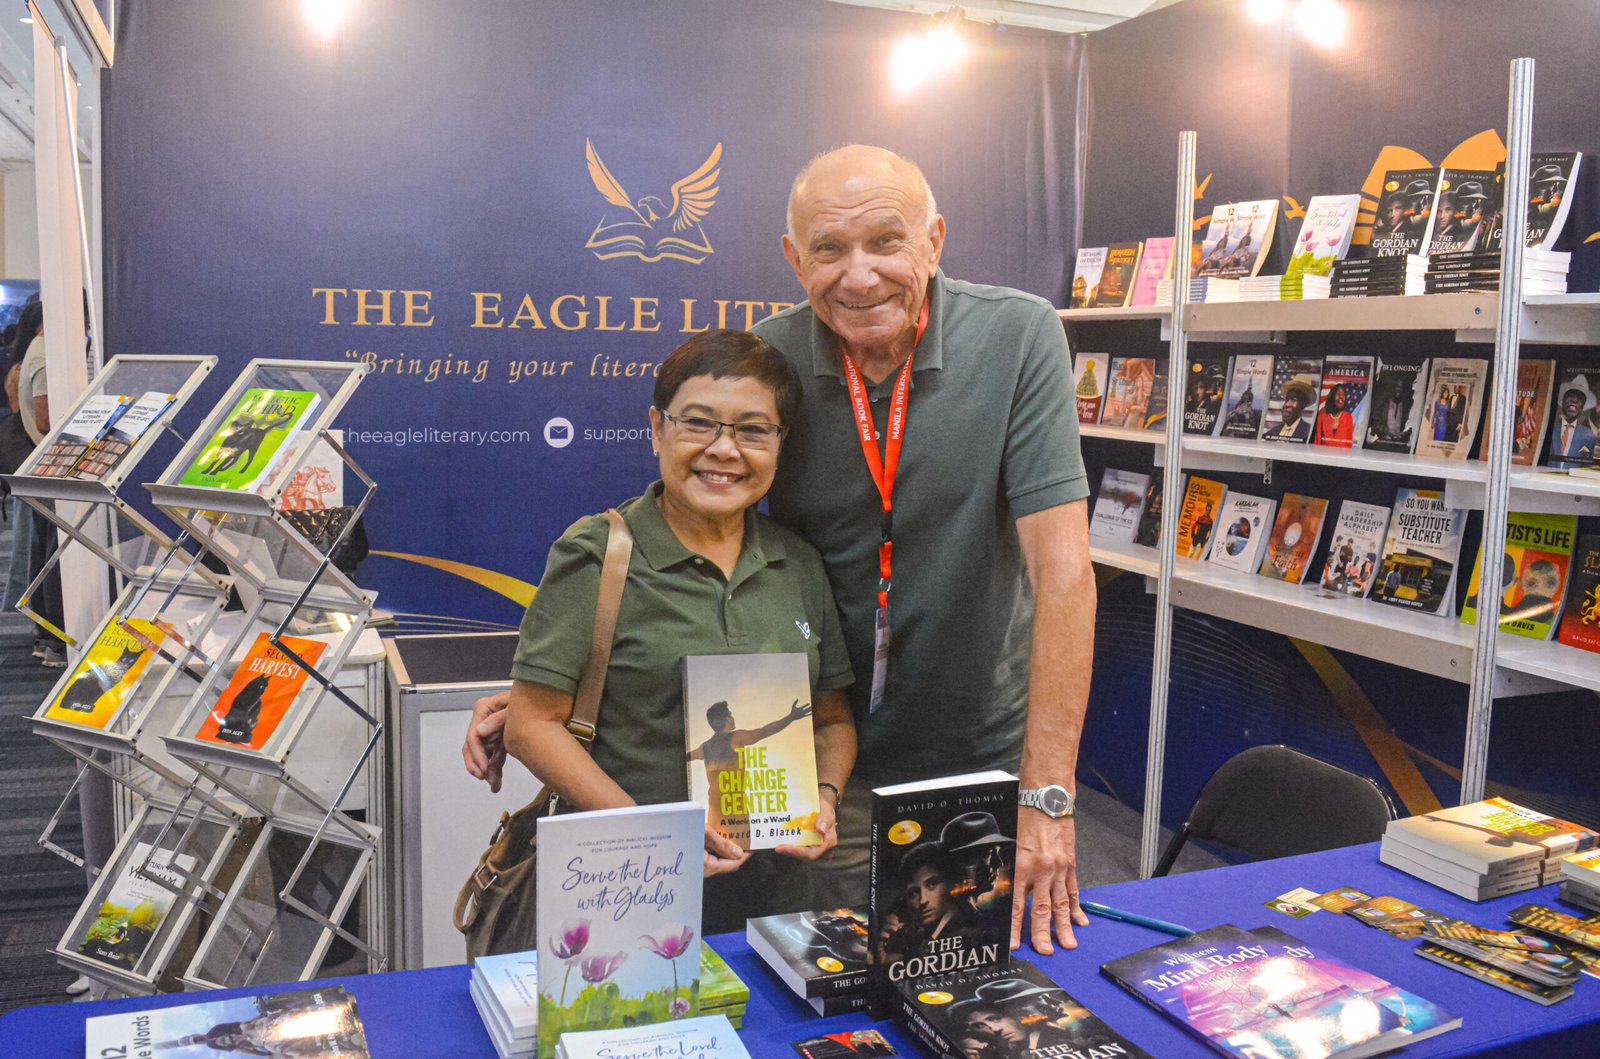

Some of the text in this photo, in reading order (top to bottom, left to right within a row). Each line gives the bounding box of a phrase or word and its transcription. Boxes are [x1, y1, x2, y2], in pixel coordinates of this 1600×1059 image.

[1228, 208, 1234, 216] 12
[1252, 205, 1259, 213] 12
[1372, 238, 1419, 248] GORDIAN
[1439, 234, 1454, 242] THE
[1378, 248, 1409, 258] KNOT
[312, 288, 435, 327] THE
[470, 292, 661, 332] EAGLE
[508, 360, 573, 383] your
[1250, 360, 1256, 368] 12
[1328, 368, 1365, 376] AMERICA
[1382, 364, 1422, 372] BELONGING
[855, 398, 867, 422] BOOK
[861, 424, 871, 442] FAIR
[892, 407, 902, 440] MANILA
[1184, 412, 1216, 422] GORDIAN
[1188, 421, 1210, 430] KNOT
[584, 427, 652, 443] support
[1178, 482, 1200, 537] MEMOIRS
[1354, 510, 1374, 518] DAILY
[1406, 498, 1448, 512] SO YOU WAN
[1341, 514, 1384, 527] LEADERSHIP
[1344, 522, 1378, 534] ALPHABET
[1398, 514, 1451, 532] SUBSTITUTE
[1402, 526, 1442, 544] TEACHER
[1544, 528, 1571, 549] LIFE
[1272, 554, 1297, 570] Faith
[1512, 620, 1535, 631] DAVIS
[248, 658, 301, 679] HARVEST
[734, 746, 768, 768] THE
[718, 768, 788, 792] CHANGE
[720, 791, 788, 816] CENTER
[898, 794, 1004, 813] DAVID O. THOMAS
[770, 815, 790, 823] Ward
[716, 827, 802, 839] oward D. Blazek
[562, 851, 684, 891] Serve the Lord
[578, 880, 678, 922] with Gladys
[928, 936, 963, 954] THE
[888, 944, 999, 982] GORDIAN
[1163, 946, 1218, 967] Wellness
[1142, 944, 1270, 992] Mind-Body
[1196, 964, 1252, 989] Activities
[833, 978, 852, 988] THE
[916, 981, 953, 990] DAVID
[976, 968, 1023, 980] THOMAS
[131, 1016, 152, 1050] Words
[903, 1002, 950, 1052] THE GORDIAN KNOT
[651, 1046, 679, 1058] the
[680, 1036, 723, 1055] Lord
[1030, 1044, 1074, 1058] THE
